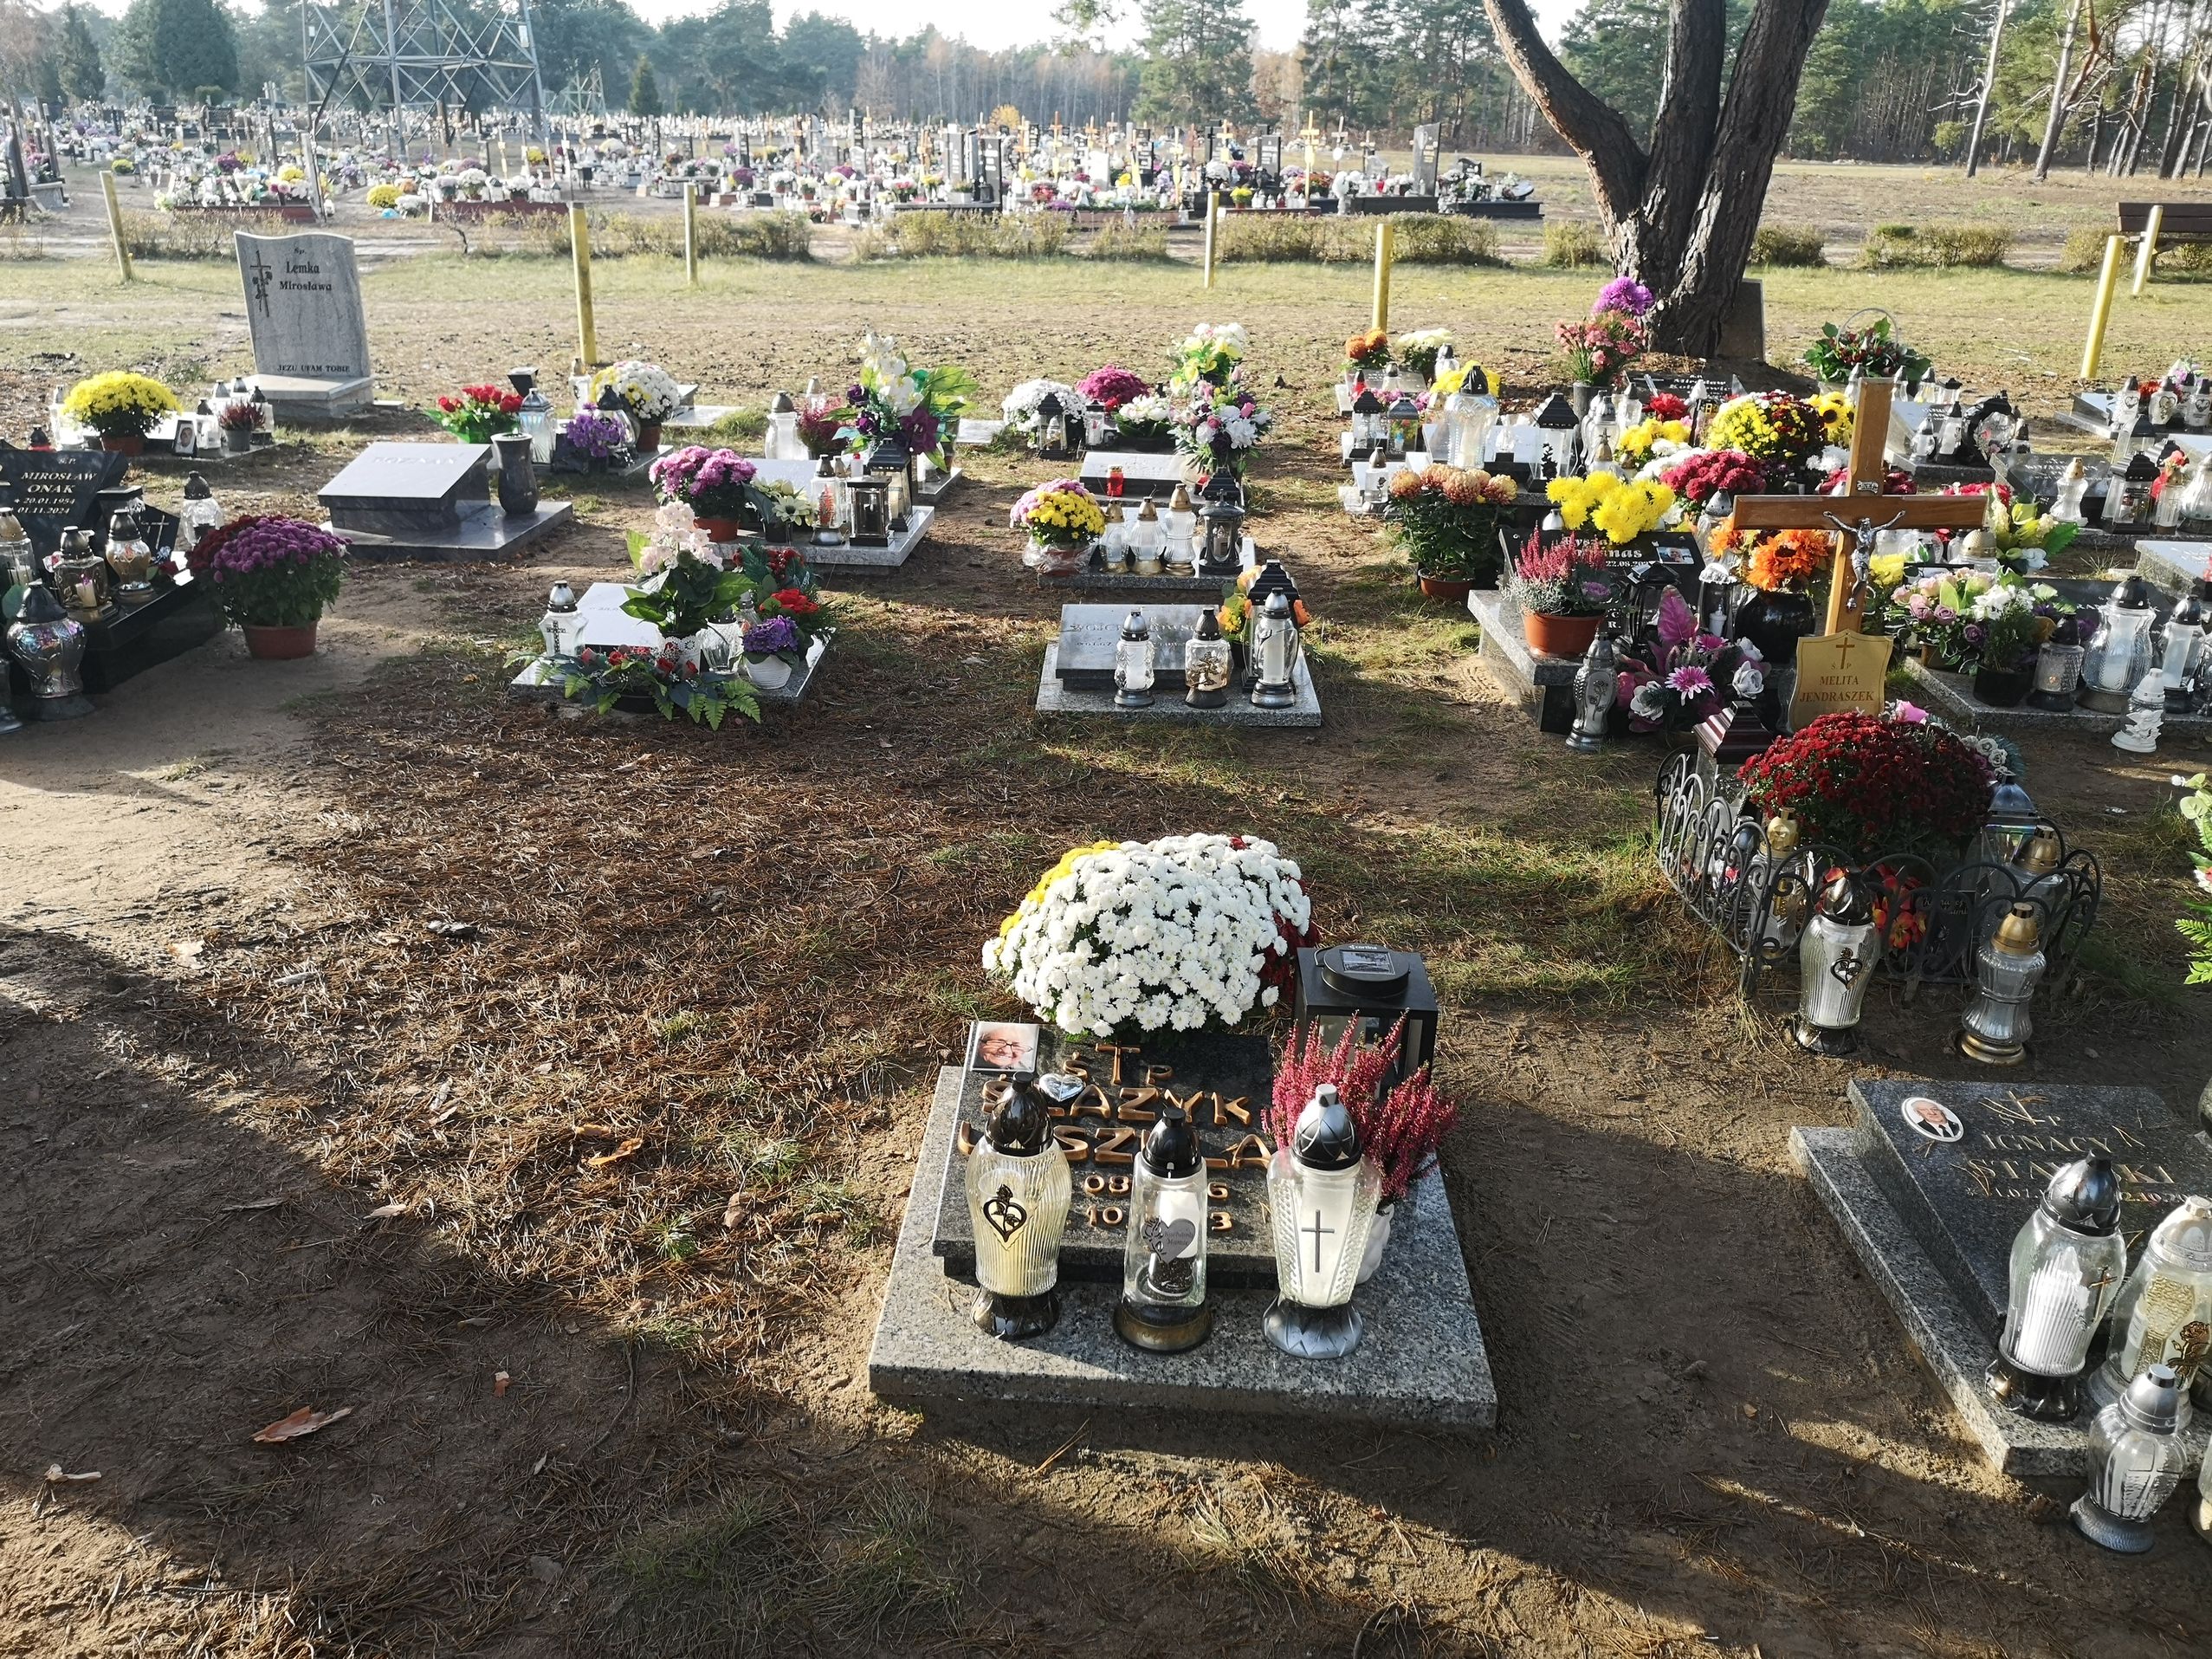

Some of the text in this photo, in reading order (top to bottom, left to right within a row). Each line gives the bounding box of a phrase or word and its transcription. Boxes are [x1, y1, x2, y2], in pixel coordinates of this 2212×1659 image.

[286, 261, 320, 275] Lemka
[279, 281, 332, 291] Mirosława
[21, 472, 97, 481] MIROSŁAW
[27, 484, 75, 494] ONAK
[1820, 676, 1859, 685] MELITA
[1800, 691, 1873, 703] JENDRASZEK
[1982, 1131, 2112, 1153] IGNACY
